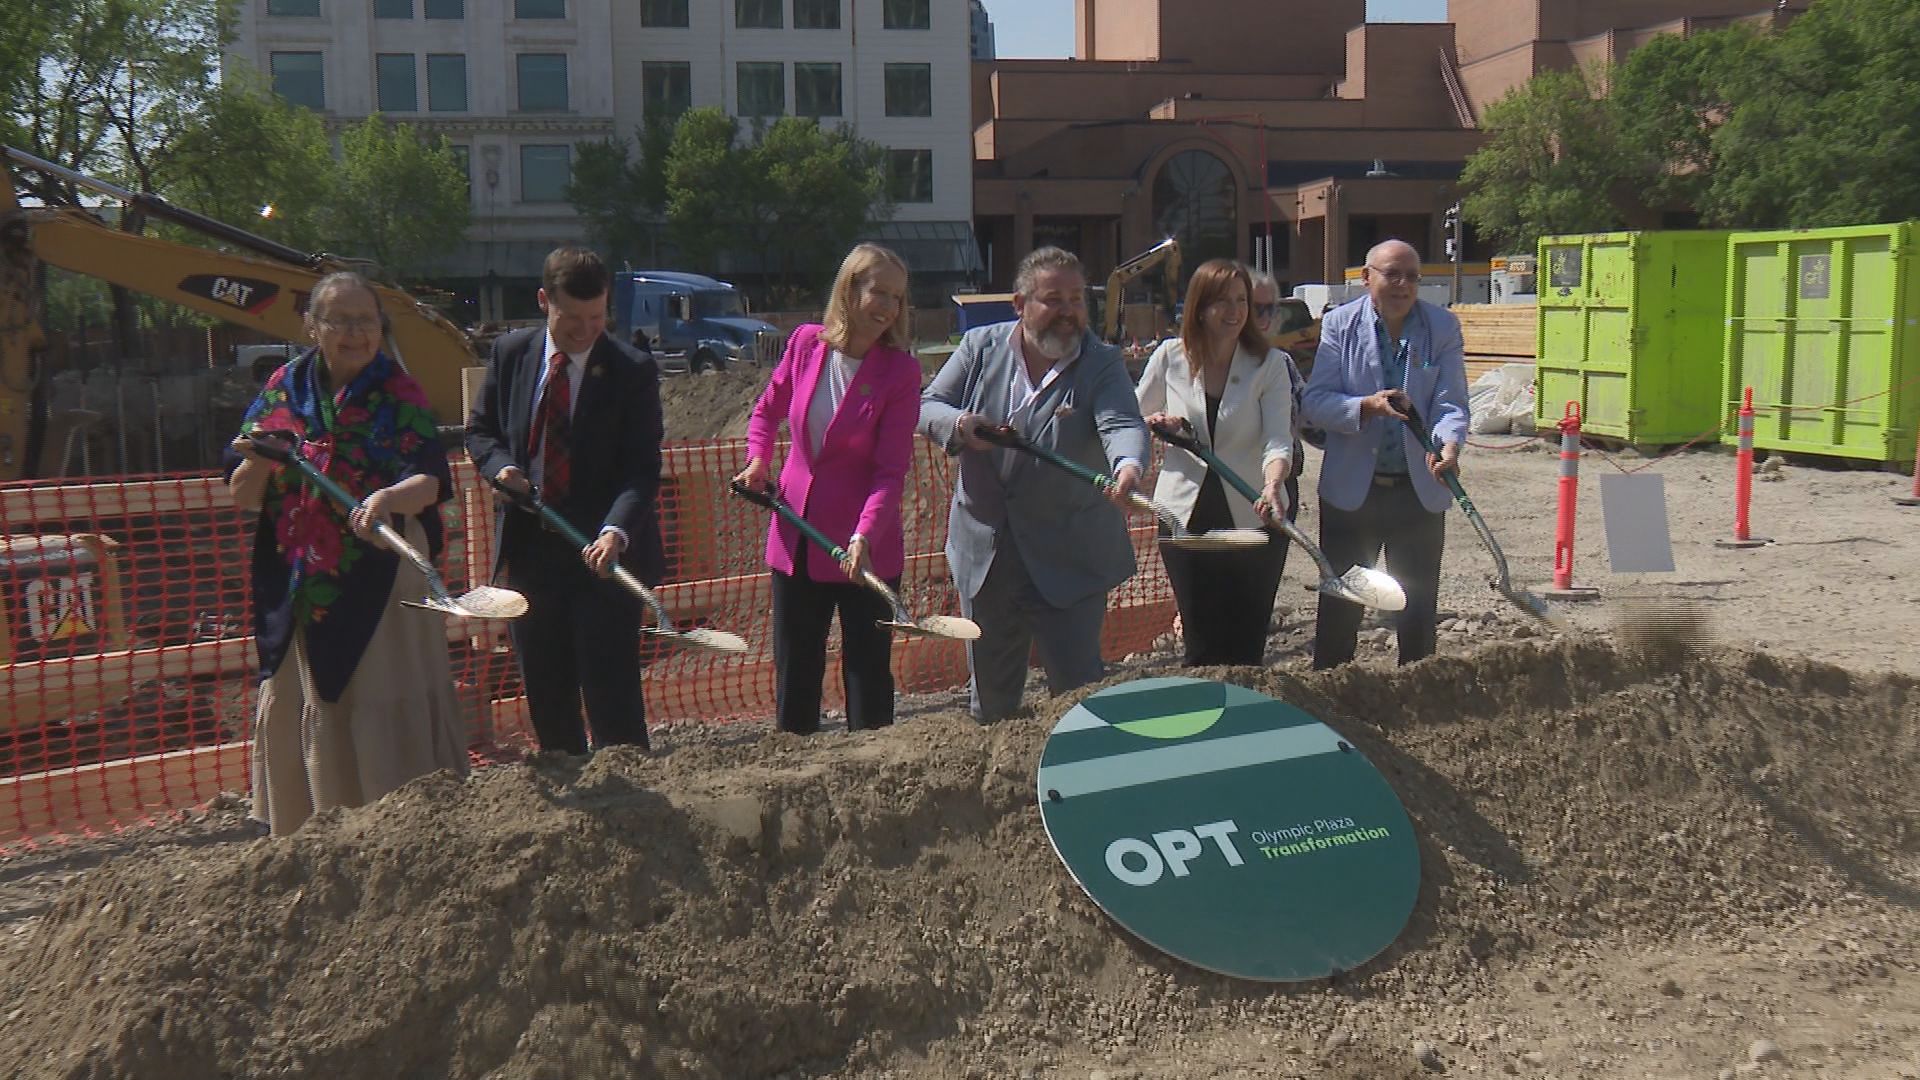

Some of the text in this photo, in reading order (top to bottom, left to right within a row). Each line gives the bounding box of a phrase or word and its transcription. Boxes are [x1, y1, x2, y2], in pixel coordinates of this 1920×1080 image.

[211, 276, 254, 306] CAT
[25, 571, 97, 643] CAT
[1251, 817, 1355, 845] Olympic Plaza
[1259, 826, 1391, 859] Transformation
[1105, 819, 1245, 887] OPT
